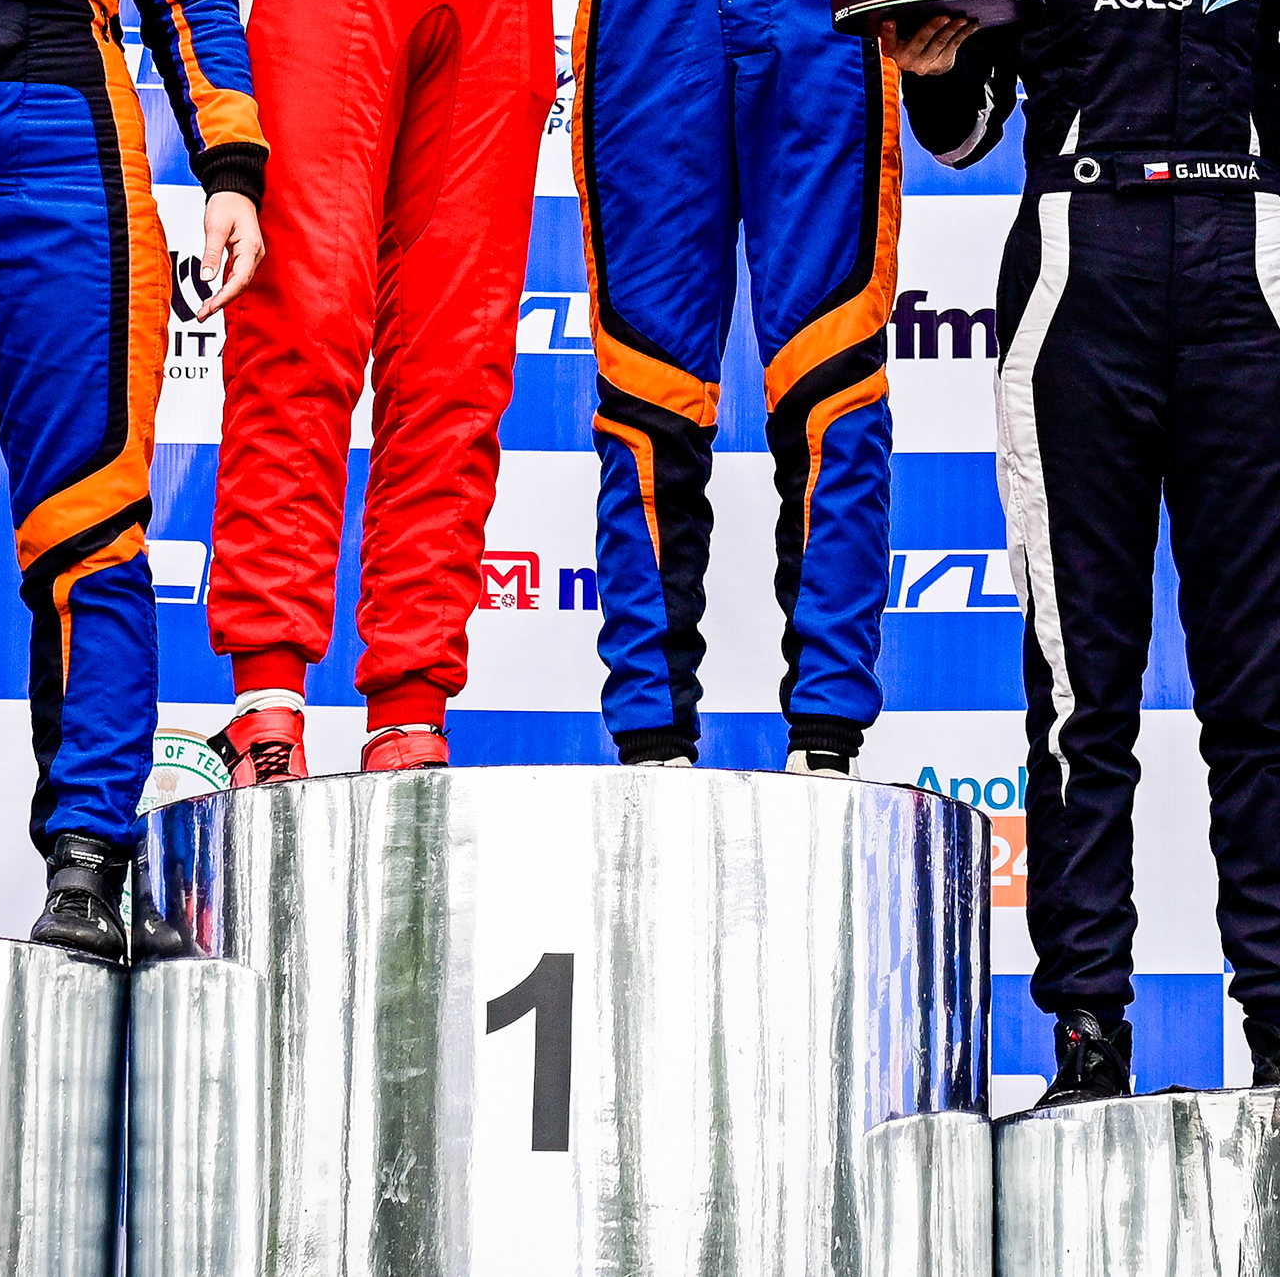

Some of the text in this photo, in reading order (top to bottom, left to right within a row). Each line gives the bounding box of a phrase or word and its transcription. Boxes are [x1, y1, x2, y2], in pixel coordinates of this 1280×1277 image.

[1176, 160, 1261, 182] G.JILKOVÁ
[165, 745, 185, 760] OF
[486, 953, 575, 1152] 1
